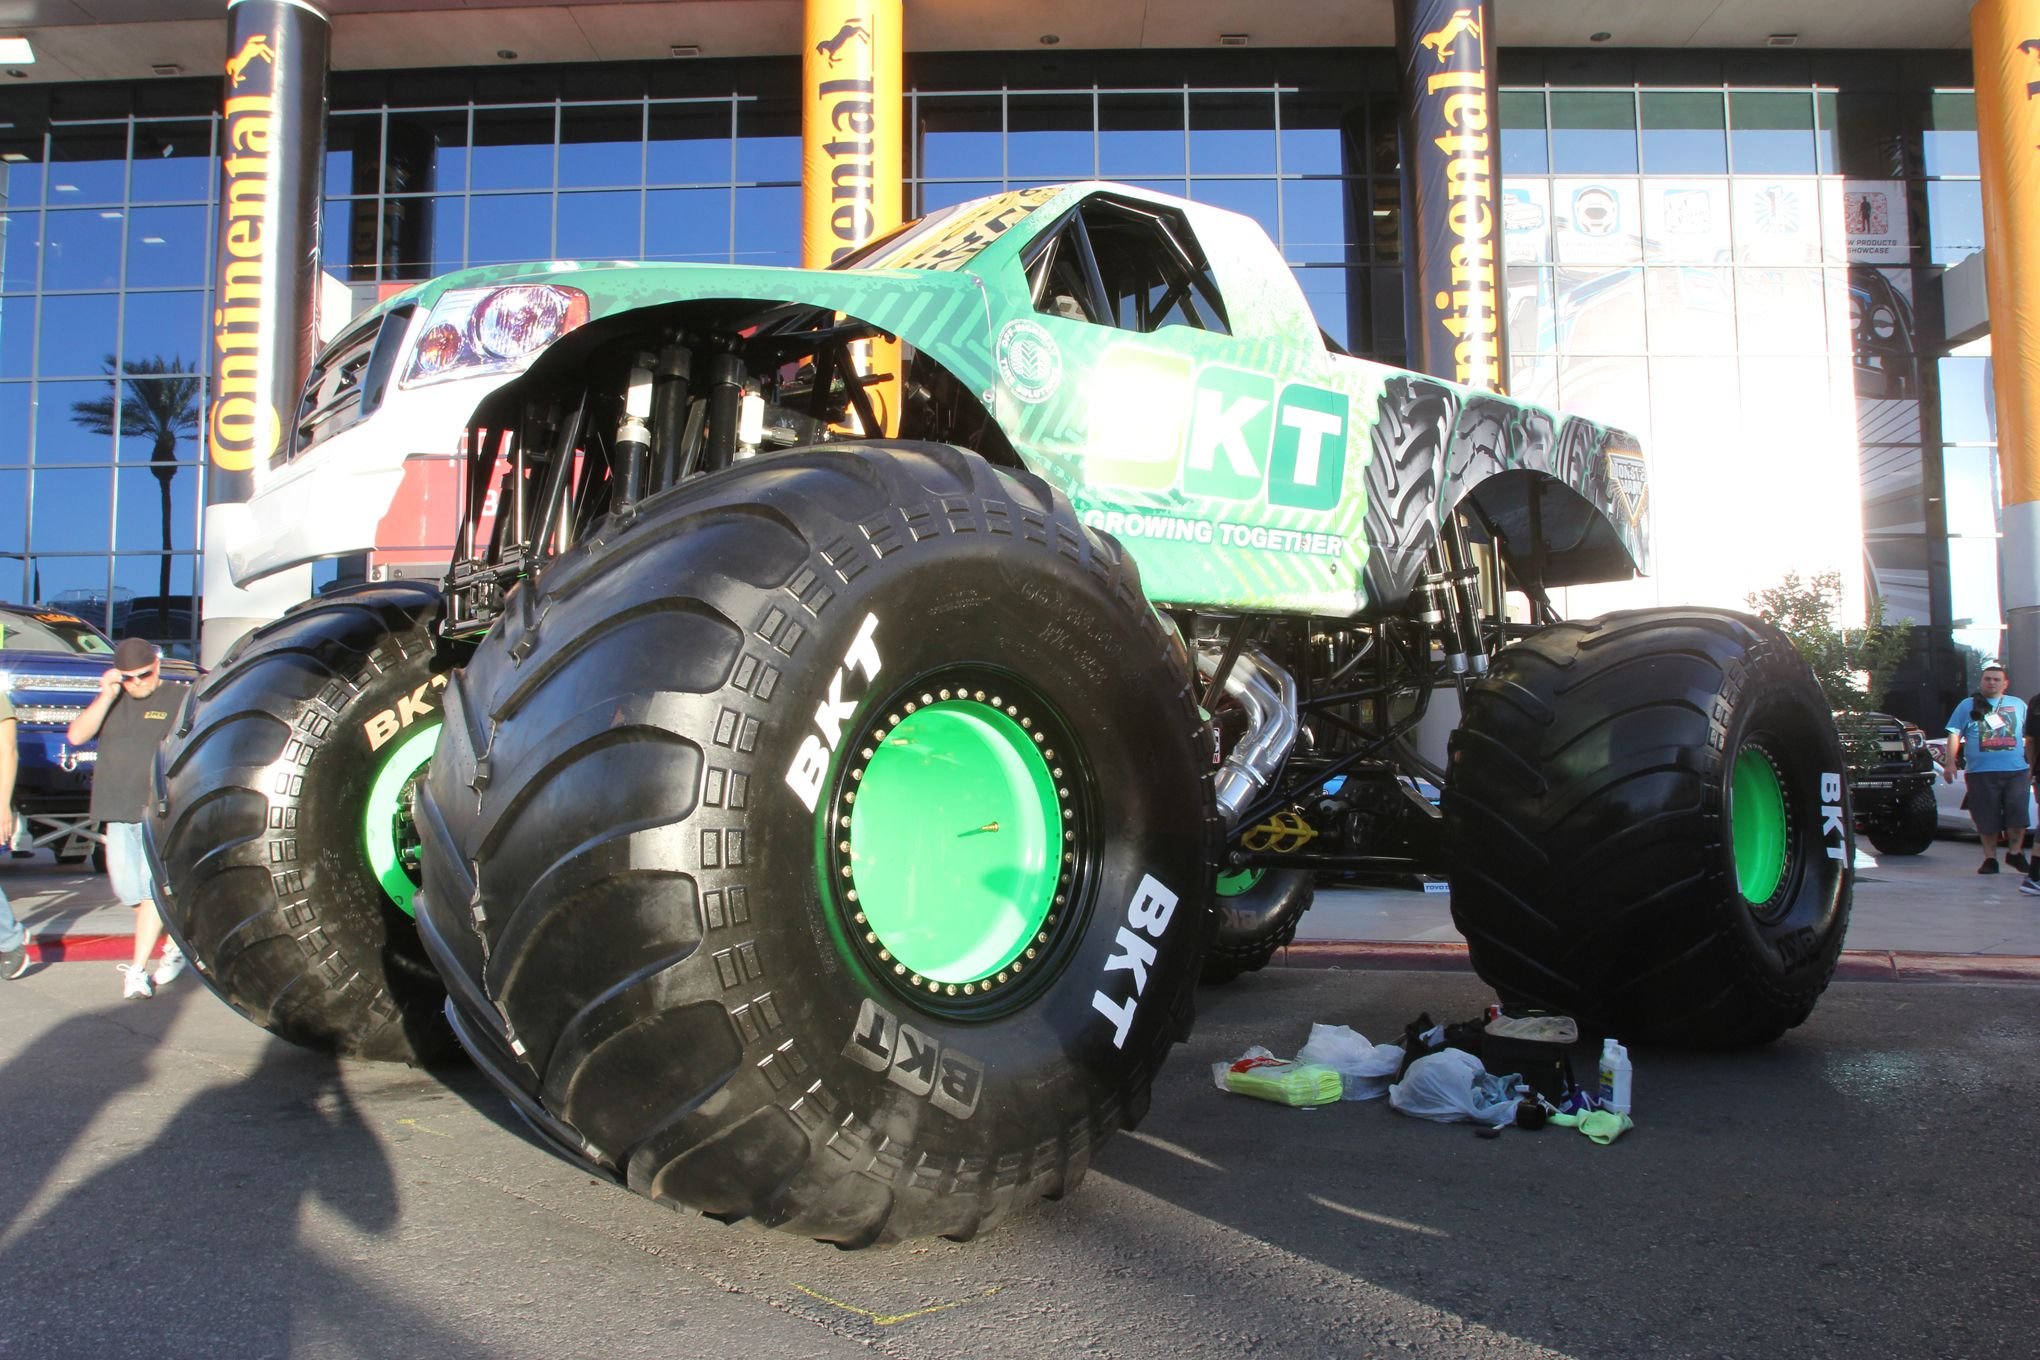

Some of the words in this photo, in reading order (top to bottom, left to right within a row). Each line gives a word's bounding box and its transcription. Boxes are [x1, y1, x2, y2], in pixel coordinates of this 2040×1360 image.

[209, 93, 281, 472] Continental
[1427, 68, 1500, 388] ntinental
[1092, 372, 1345, 490] KT
[1084, 510, 1213, 544] GROWING
[1219, 522, 1345, 557] TOGETHER
[785, 612, 882, 814] BKT
[1820, 772, 1849, 869] BKT
[1091, 872, 1180, 1051] BKT
[848, 1004, 982, 1112] BKT
